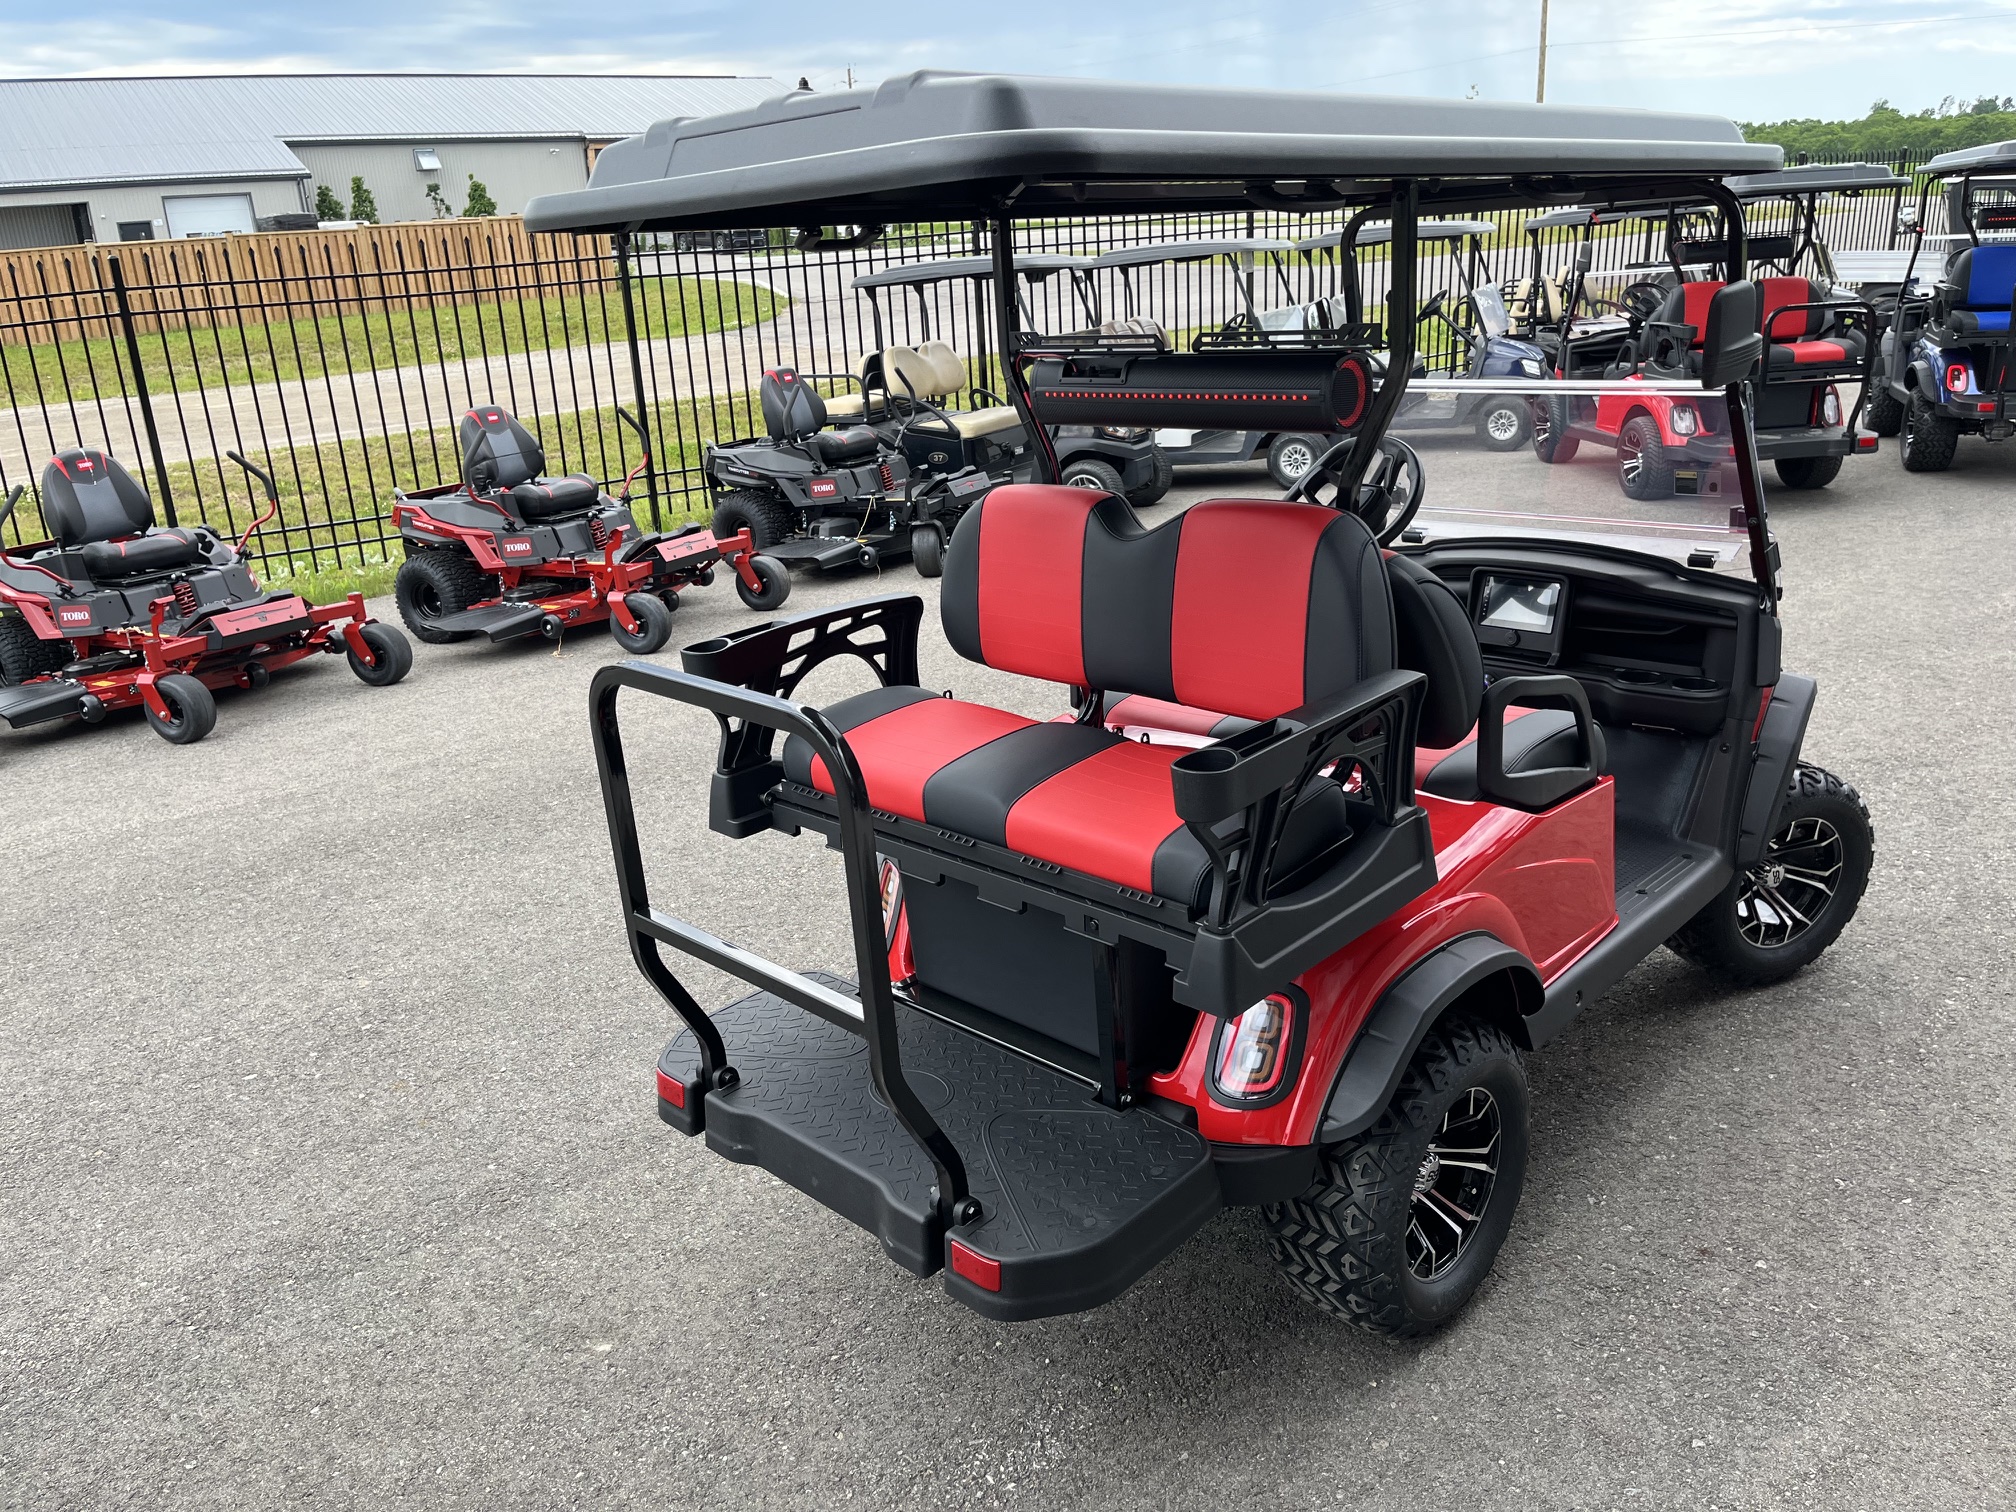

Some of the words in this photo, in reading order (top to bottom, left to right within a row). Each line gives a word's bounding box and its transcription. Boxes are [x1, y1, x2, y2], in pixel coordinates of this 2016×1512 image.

[813, 484, 834, 493] TORO
[505, 543, 530, 552] TORO
[61, 612, 89, 621] TORO
